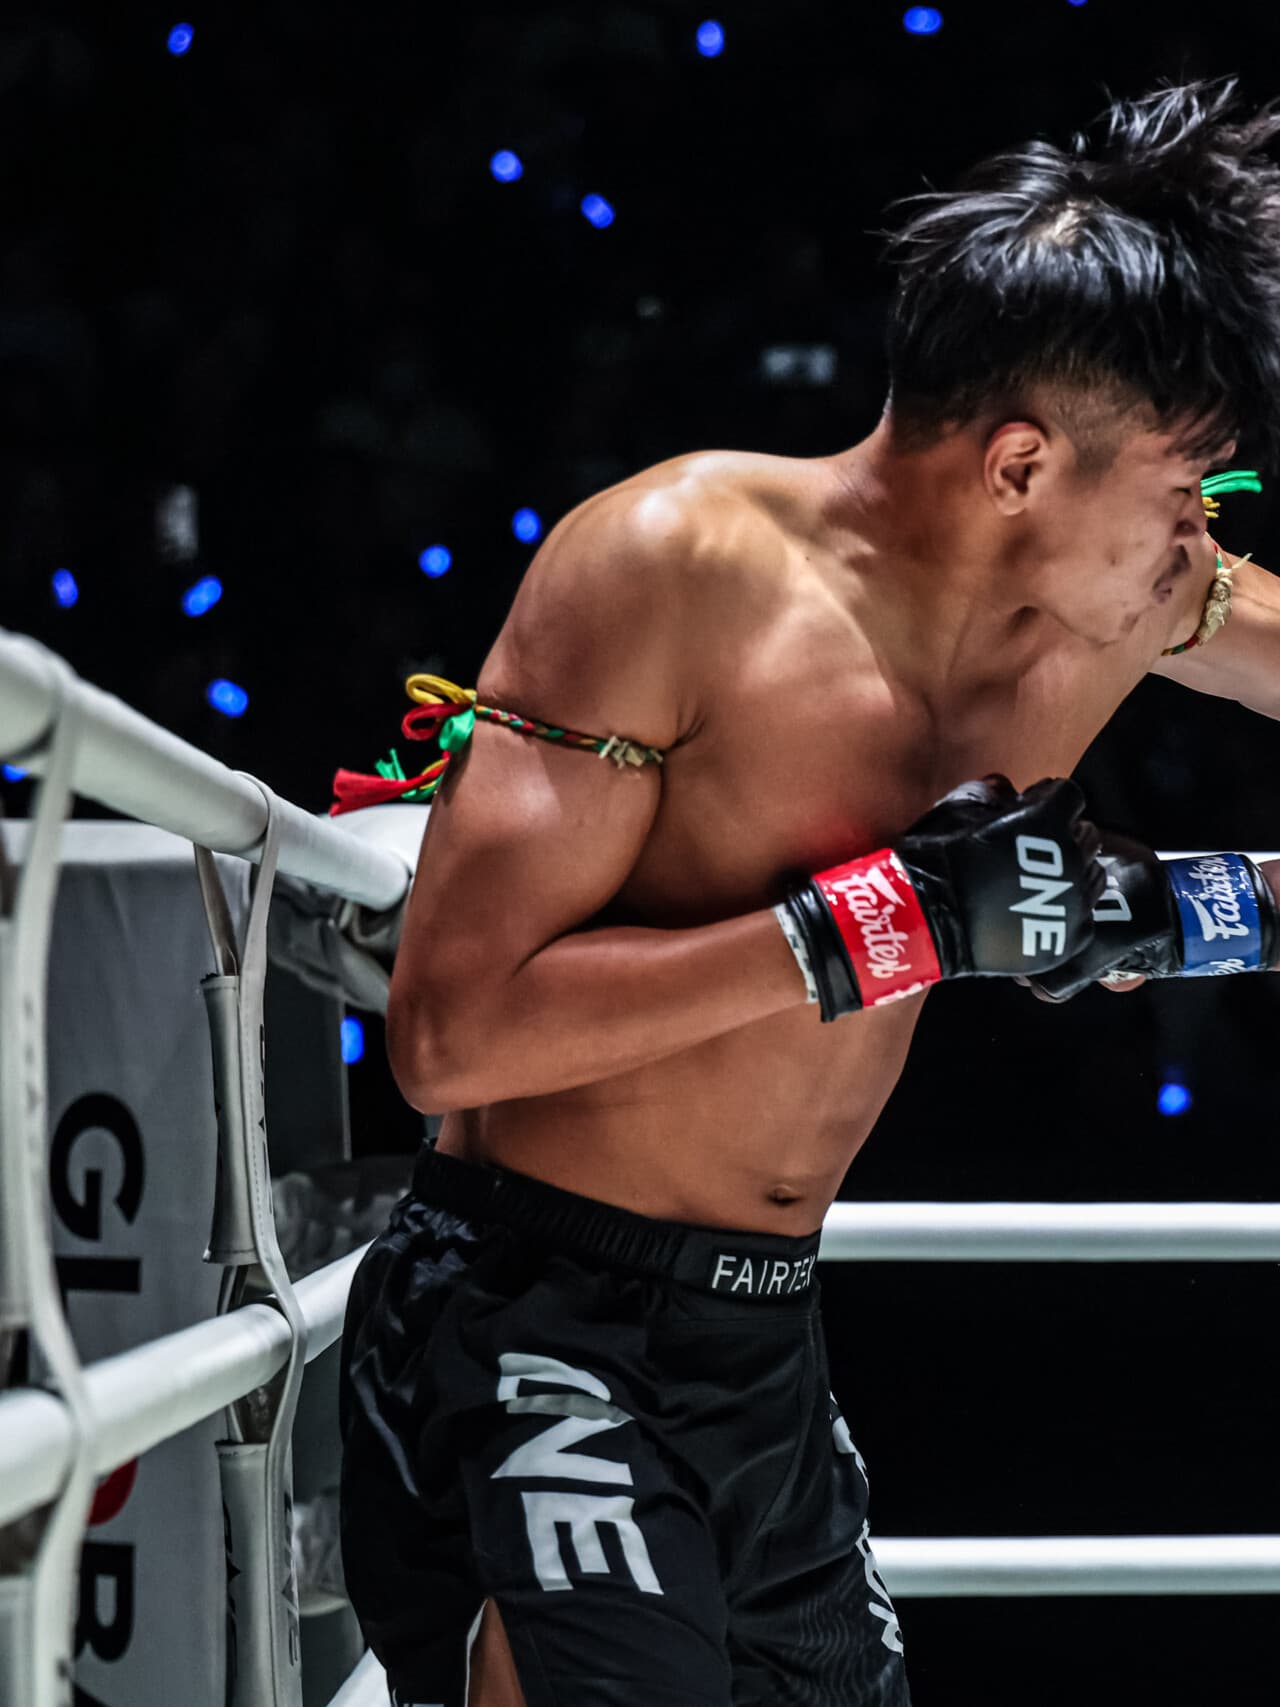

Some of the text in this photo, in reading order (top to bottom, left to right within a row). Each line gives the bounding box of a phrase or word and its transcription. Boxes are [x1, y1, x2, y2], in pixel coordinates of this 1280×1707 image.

[831, 865, 912, 979] Fairtex
[1009, 834, 1073, 956] ONE
[50, 1092, 145, 1707] GLB
[490, 1352, 665, 1596] ONE
